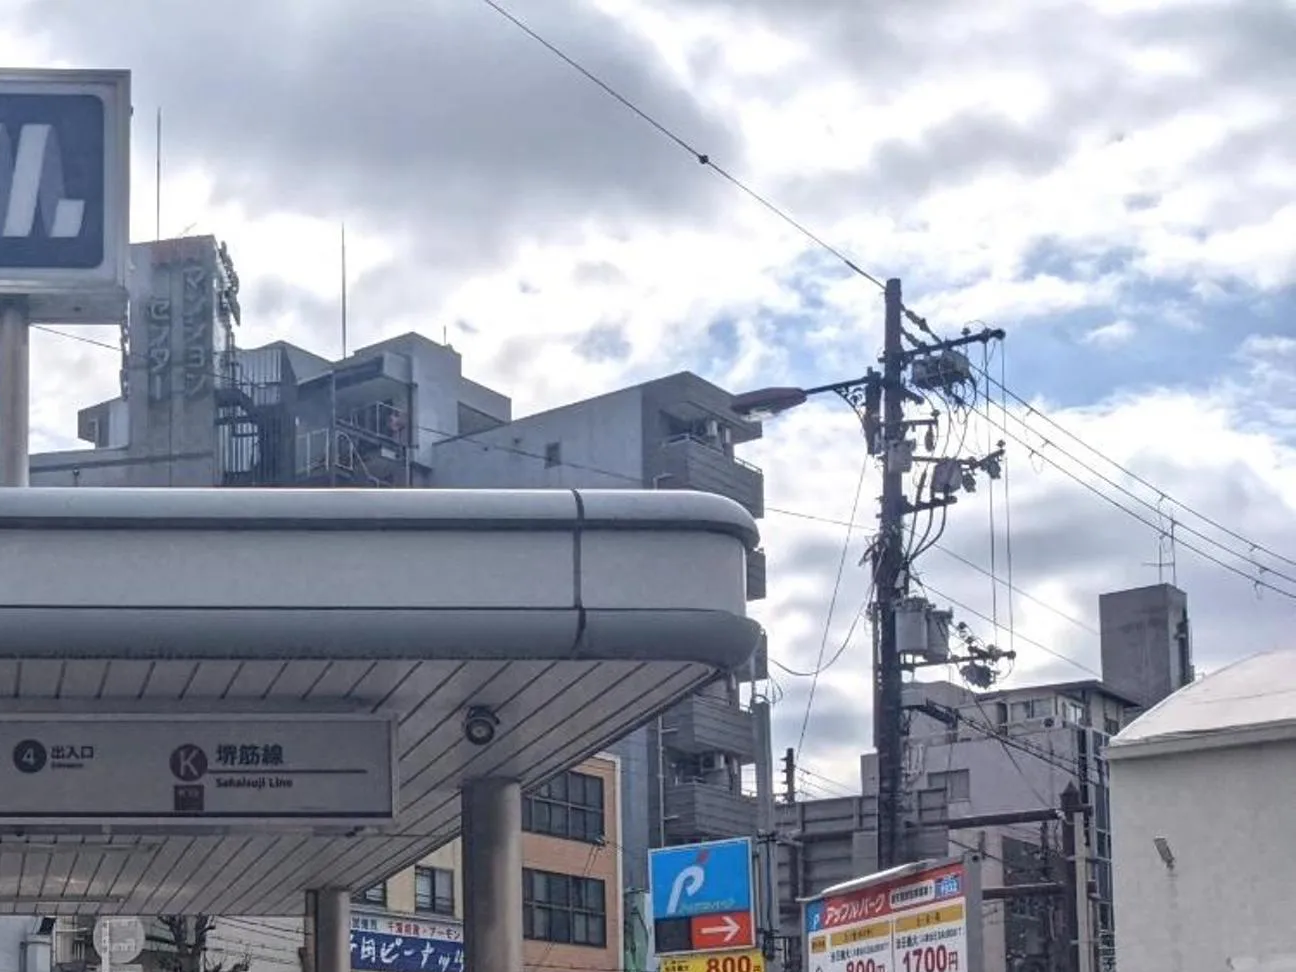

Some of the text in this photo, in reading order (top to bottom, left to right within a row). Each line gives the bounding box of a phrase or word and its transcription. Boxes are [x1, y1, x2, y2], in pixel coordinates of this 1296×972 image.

[50, 744, 95, 760] 出入口
[214, 743, 284, 767] 堺筋線
[180, 753, 199, 777] K
